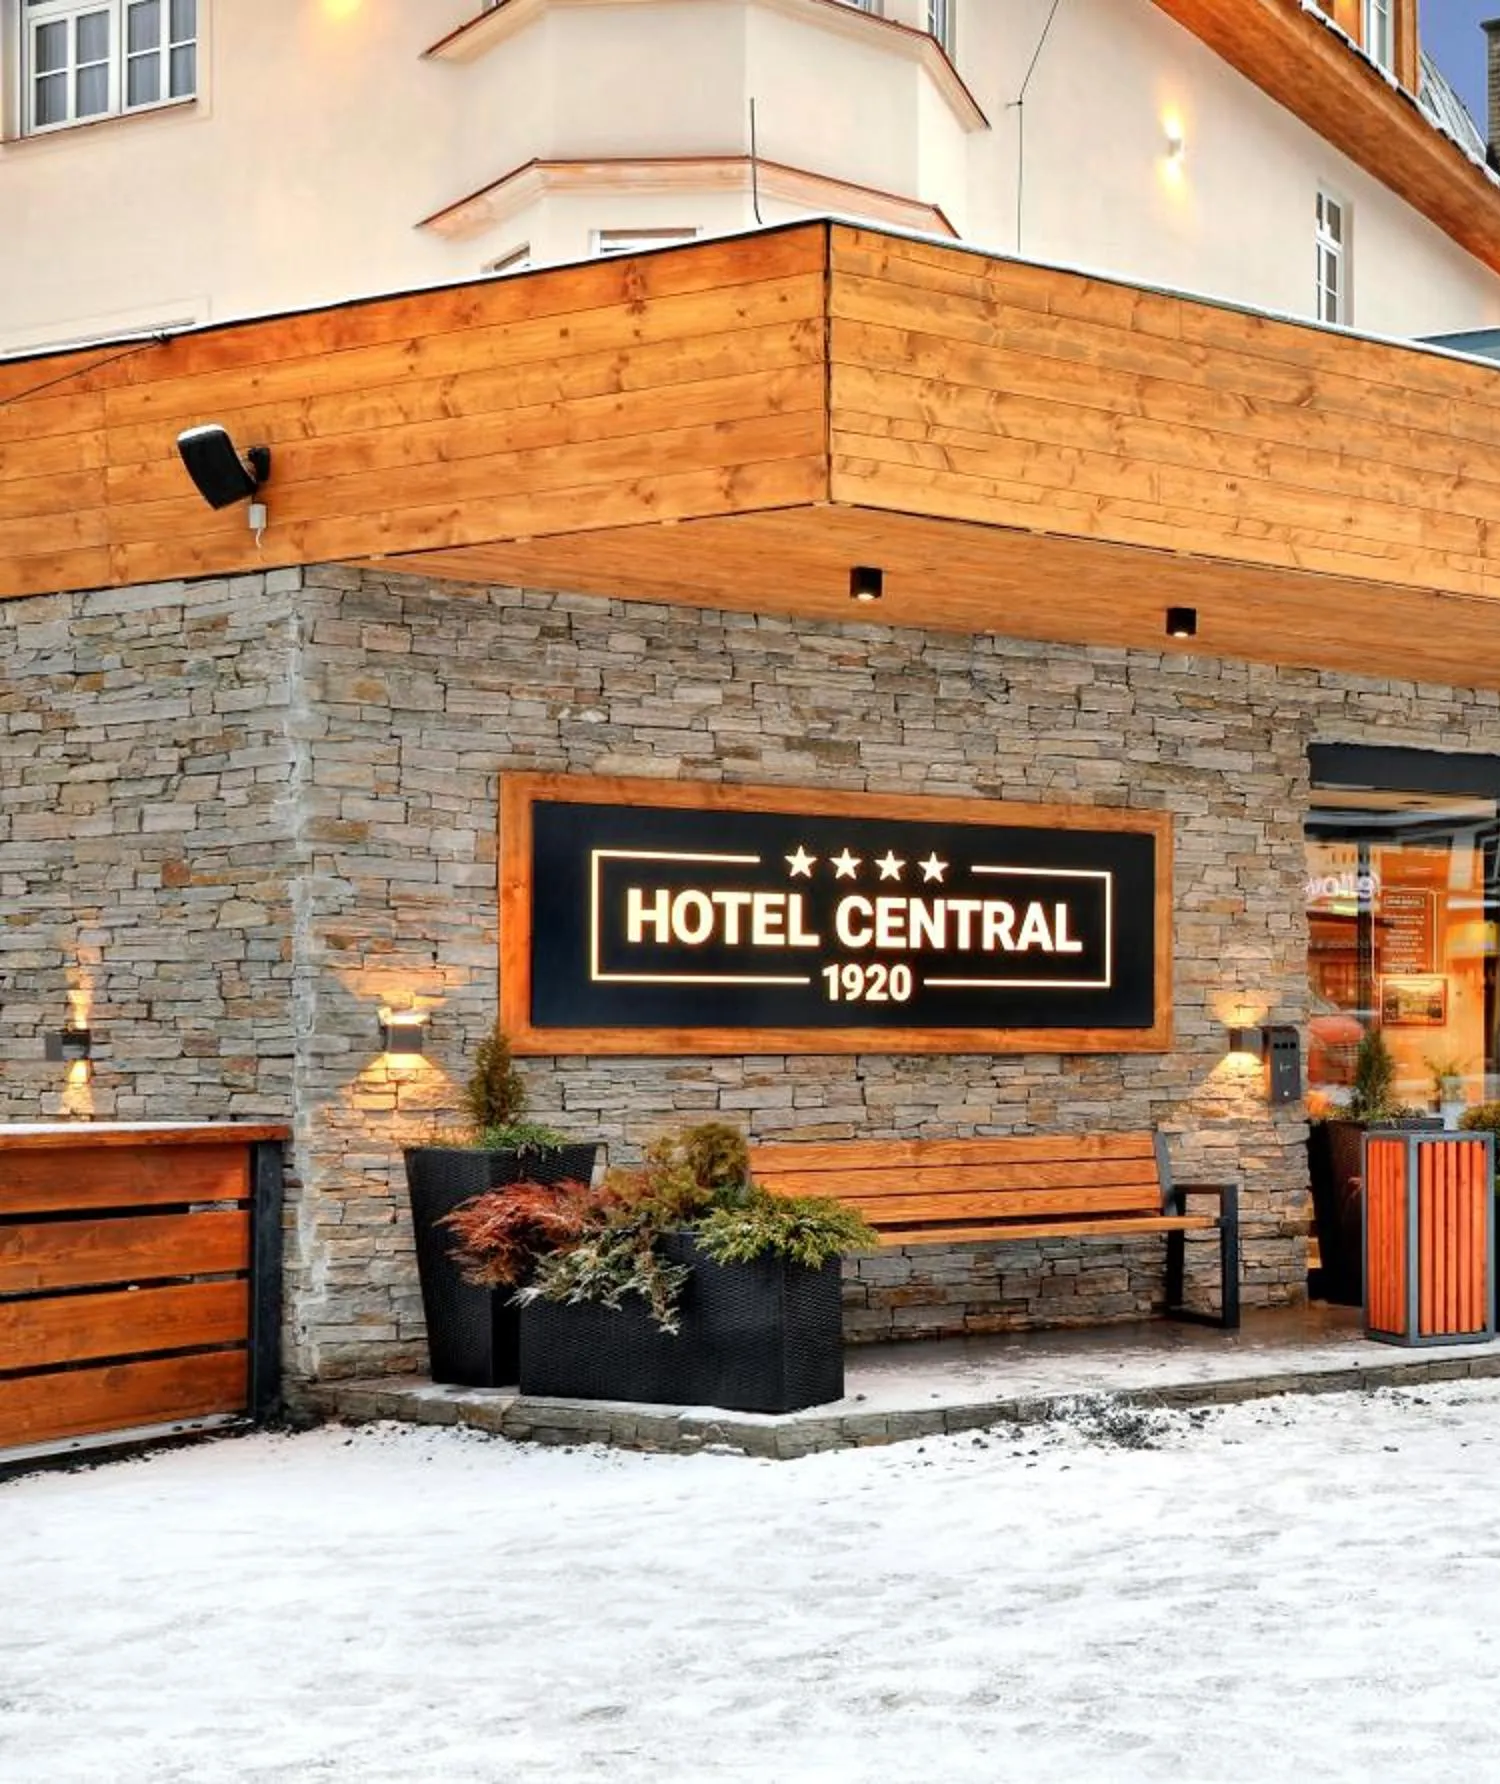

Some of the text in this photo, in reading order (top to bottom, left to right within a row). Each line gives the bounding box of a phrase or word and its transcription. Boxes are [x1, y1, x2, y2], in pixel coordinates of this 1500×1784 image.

[627, 887, 1083, 953] HOTEL CENTRAL
[821, 963, 912, 1002] 1920
